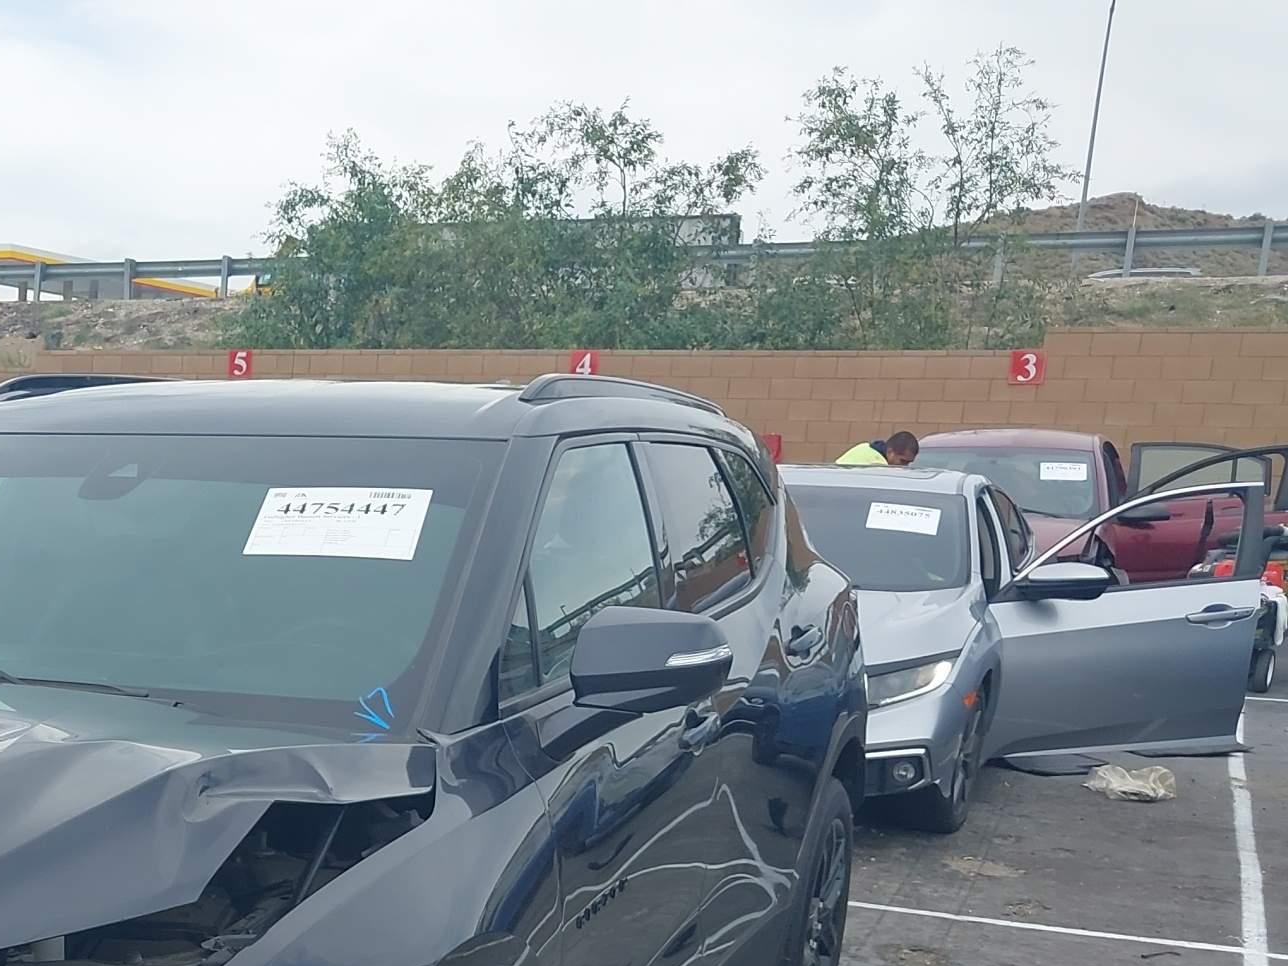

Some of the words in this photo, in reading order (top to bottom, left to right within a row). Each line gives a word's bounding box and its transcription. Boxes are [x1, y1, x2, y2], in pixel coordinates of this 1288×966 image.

[233, 351, 248, 376] 5
[575, 352, 592, 375] 4
[1016, 353, 1037, 382] 3
[276, 502, 407, 516] 44754447
